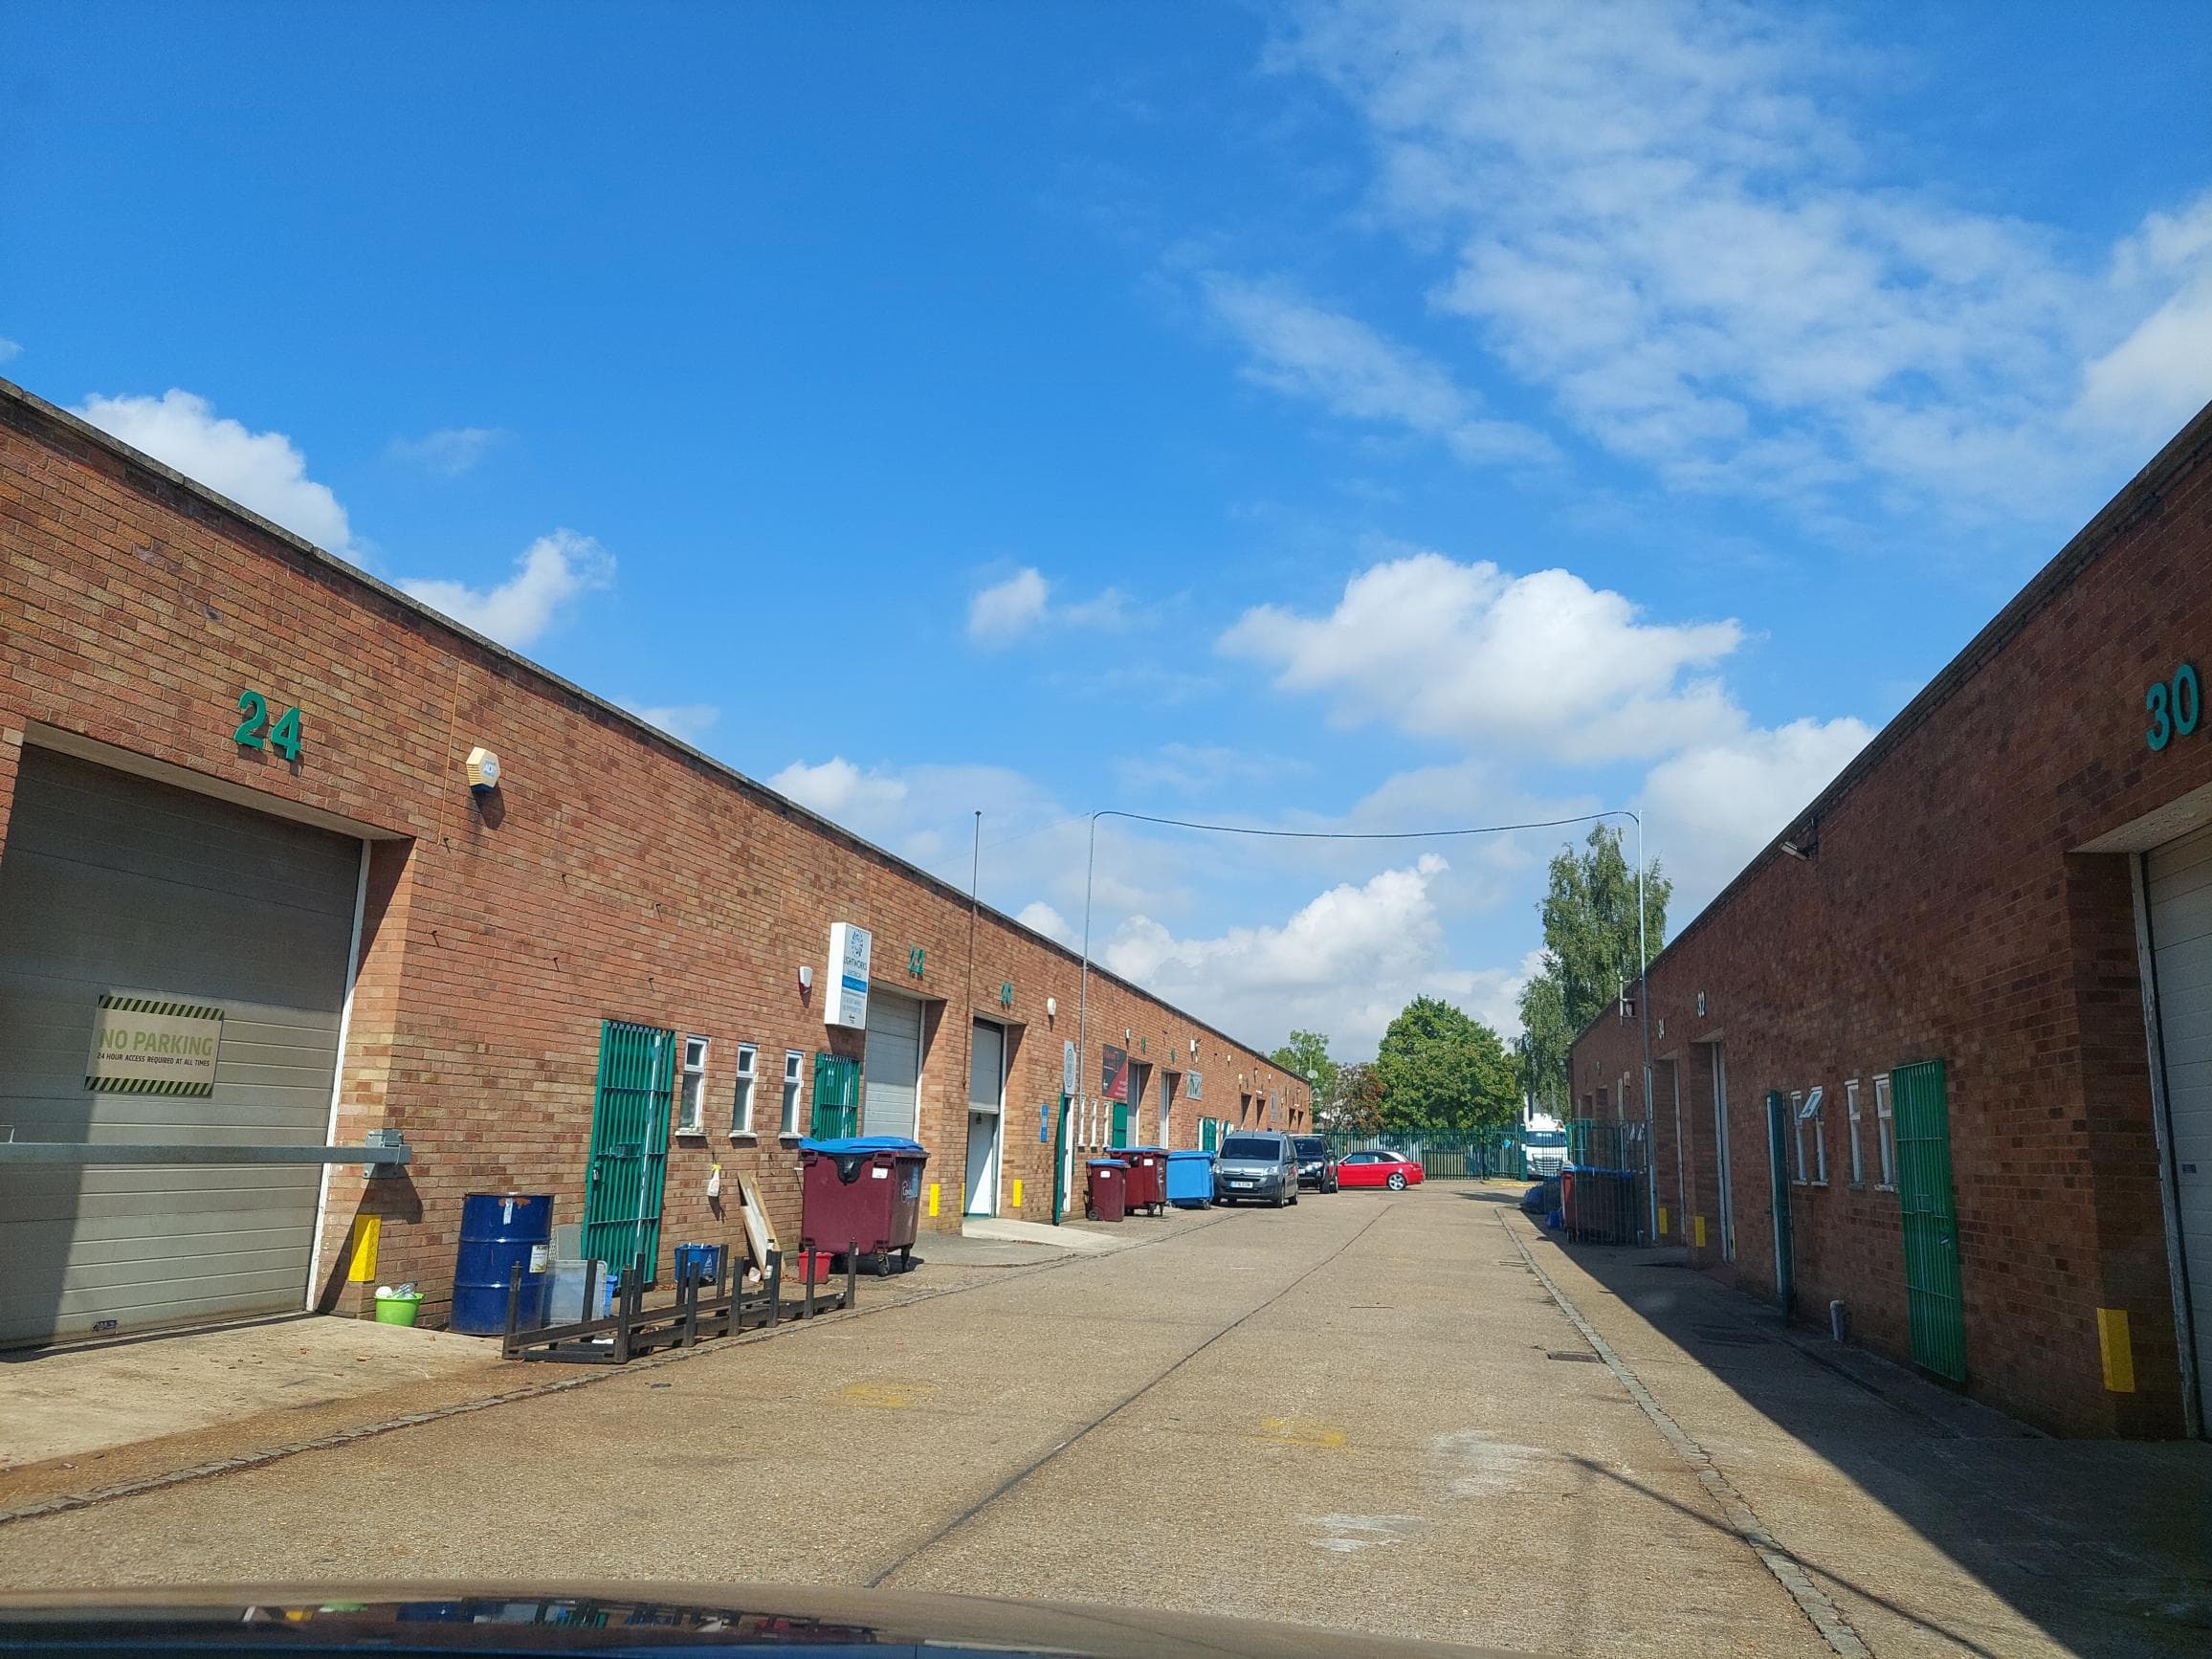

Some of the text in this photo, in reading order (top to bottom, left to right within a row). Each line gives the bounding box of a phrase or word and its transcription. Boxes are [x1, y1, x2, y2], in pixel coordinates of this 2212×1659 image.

[2146, 664, 2199, 751] 30
[233, 690, 301, 761] 24
[1697, 991, 1705, 1018] 32
[99, 1029, 213, 1056] NO PARKING
[1658, 1018, 1665, 1040] 34
[106, 1052, 123, 1061] HOUR
